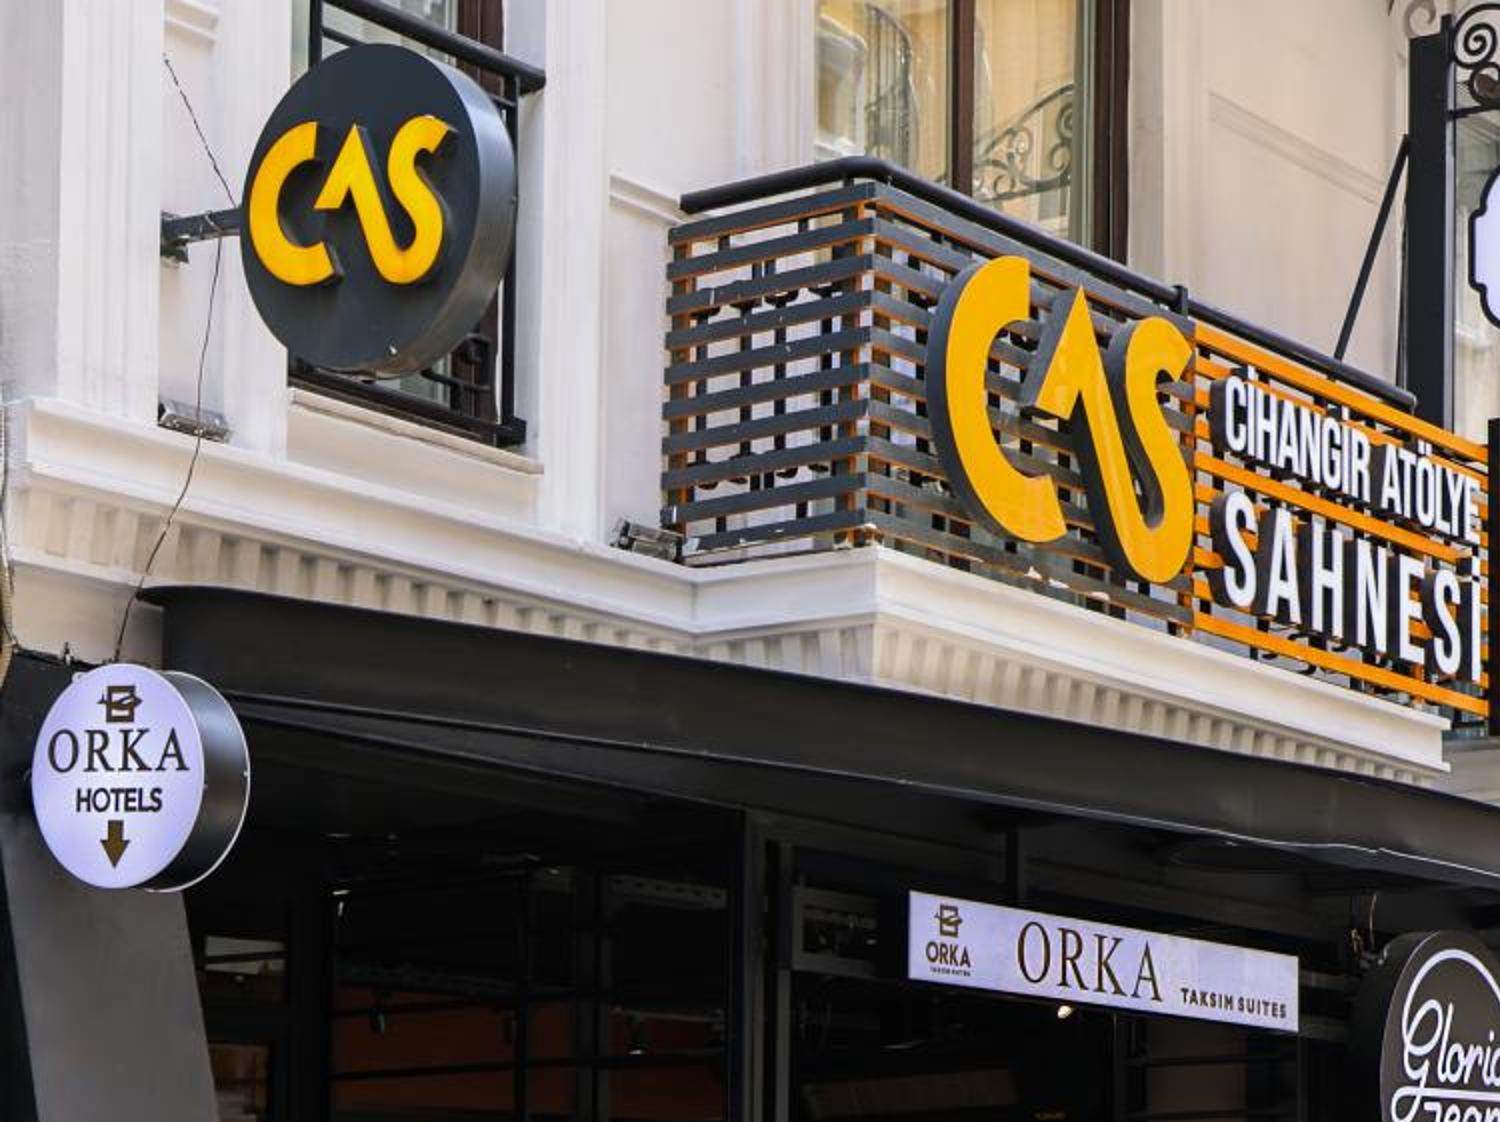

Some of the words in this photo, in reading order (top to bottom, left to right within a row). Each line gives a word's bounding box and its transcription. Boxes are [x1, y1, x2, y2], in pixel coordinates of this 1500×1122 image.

[249, 115, 450, 286] CAS
[945, 255, 1194, 584] CAS
[1224, 371, 1370, 502] CİHANGİR
[1380, 440, 1480, 544] ATÖLYE
[1223, 490, 1481, 682] SAHNESİ
[48, 728, 190, 773] ORKA
[76, 787, 163, 813] HOTELS
[926, 940, 971, 968] ORKA
[1016, 921, 1163, 1002] ORKA
[1180, 987, 1234, 1011] TAKSIM
[1237, 996, 1287, 1019] SUITES
